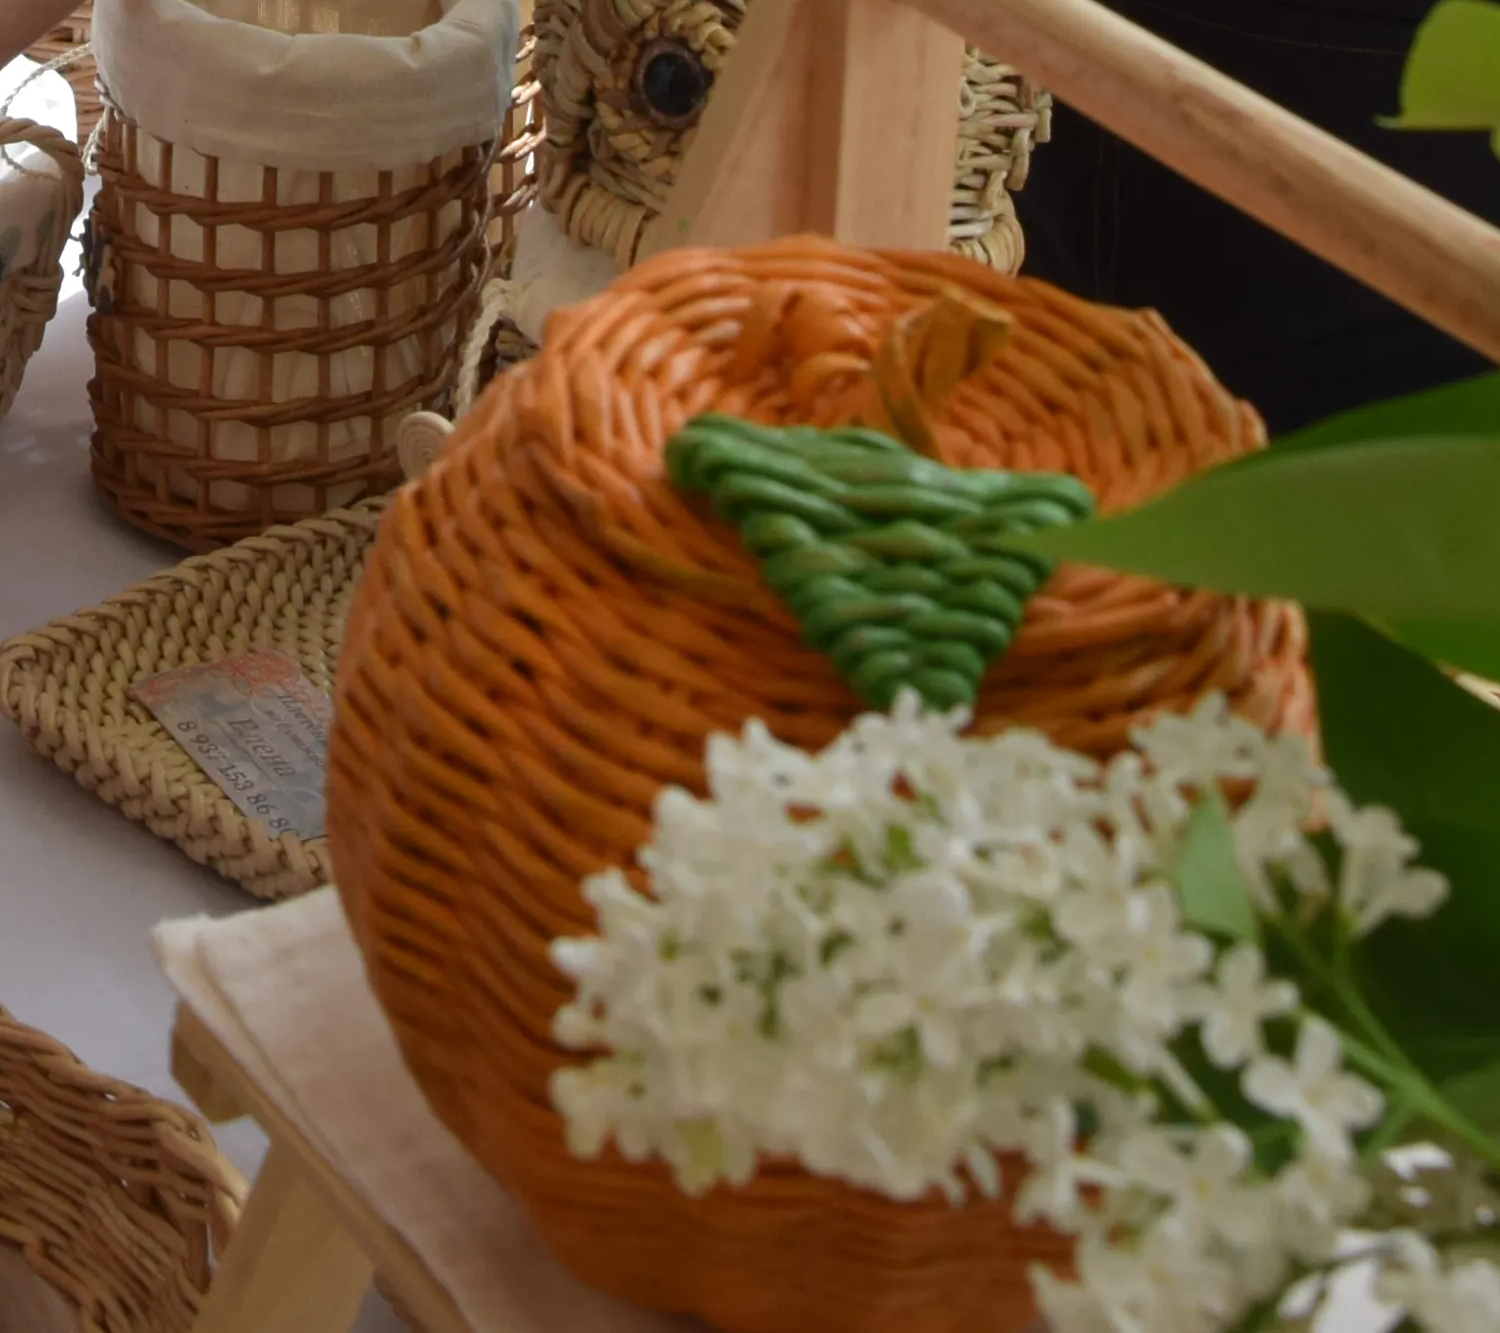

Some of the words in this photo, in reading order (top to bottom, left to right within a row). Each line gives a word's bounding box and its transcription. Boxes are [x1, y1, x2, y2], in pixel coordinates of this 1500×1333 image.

[177, 720, 197, 732] 8
[190, 734, 228, 761] 937
[217, 764, 254, 792] 153
[247, 793, 277, 814] 86
[228, 719, 296, 777] Елена
